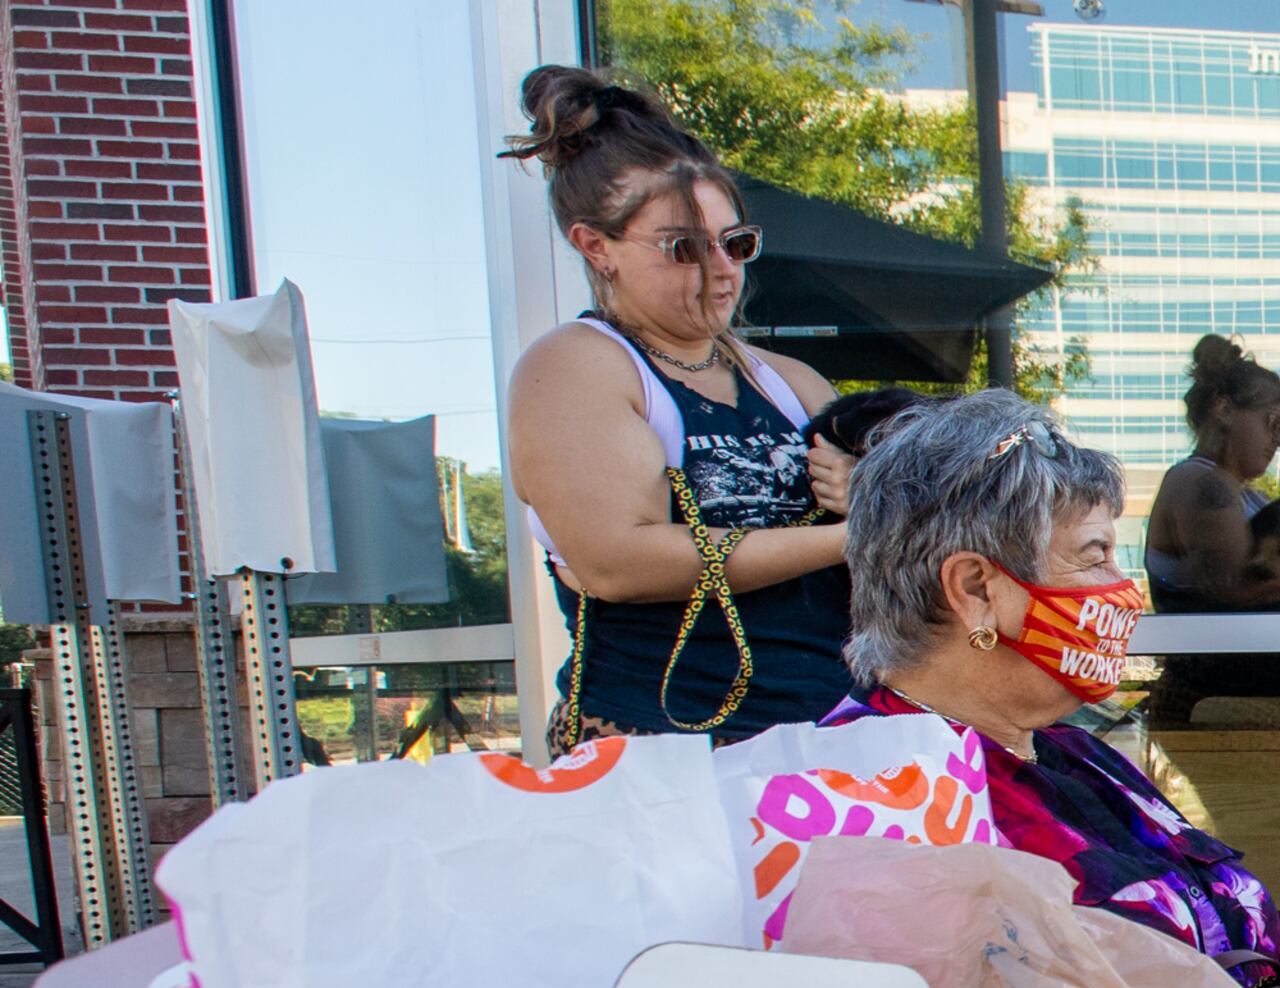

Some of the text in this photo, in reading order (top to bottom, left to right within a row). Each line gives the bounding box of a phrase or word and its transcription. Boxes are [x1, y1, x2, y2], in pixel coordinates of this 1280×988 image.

[687, 434, 741, 451] HIS
[1075, 597, 1142, 639] POWE
[1096, 638, 1110, 654] TO
[1059, 646, 1126, 686] WORKE
